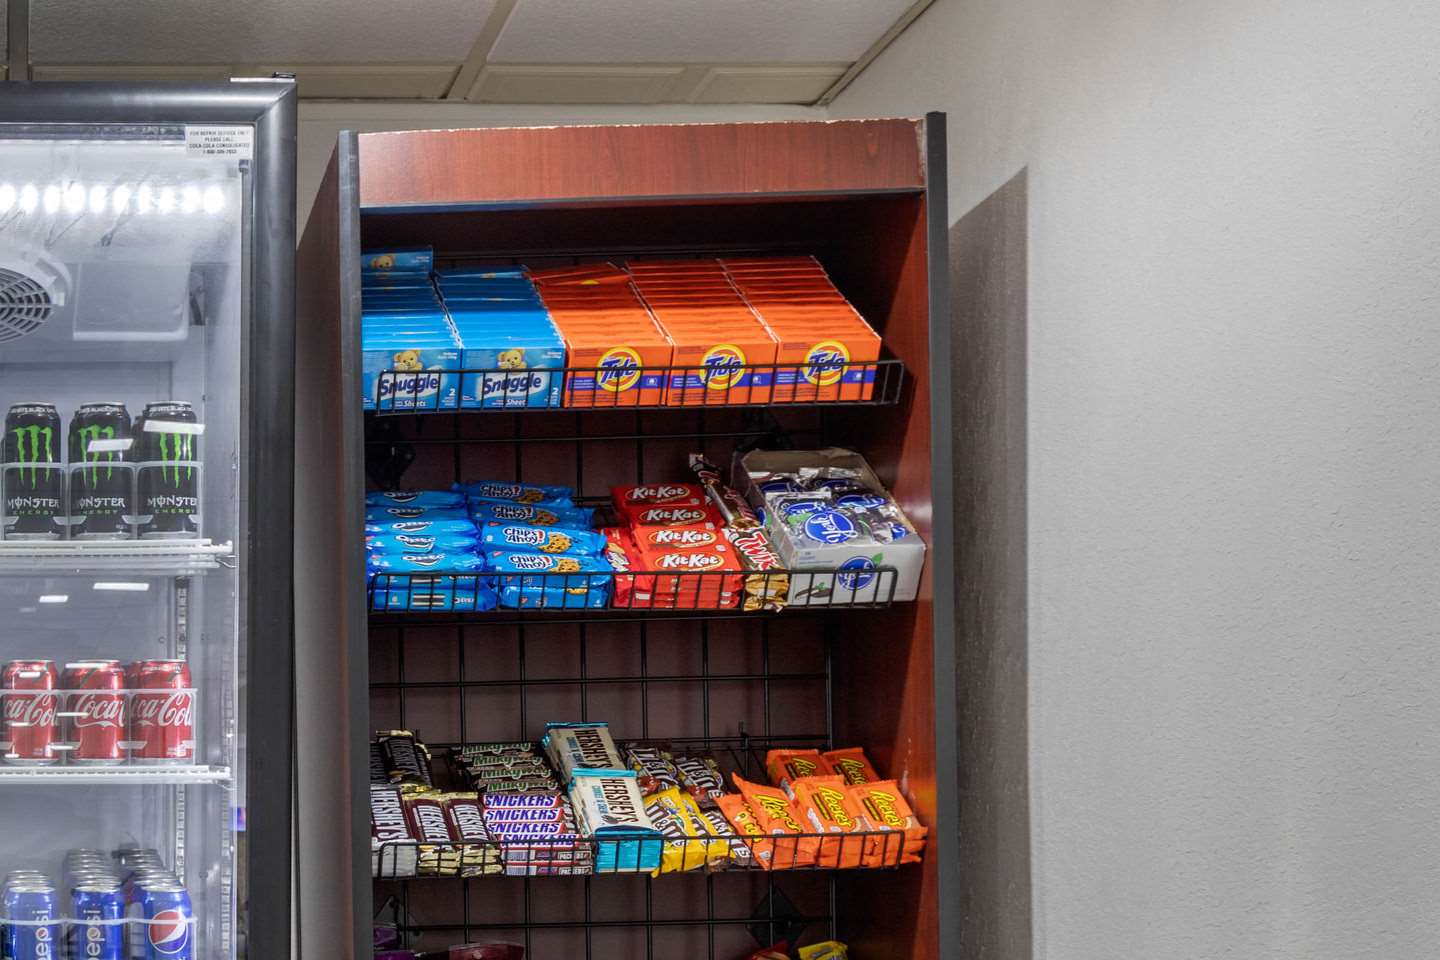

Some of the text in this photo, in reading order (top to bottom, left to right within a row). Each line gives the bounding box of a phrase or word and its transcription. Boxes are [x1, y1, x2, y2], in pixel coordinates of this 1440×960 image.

[380, 374, 439, 395] Snuggle
[484, 373, 542, 394] Snuggle
[79, 496, 125, 509] ONSTER
[484, 794, 556, 807] SNICKERS
[485, 808, 558, 821] SNICKERS
[488, 822, 560, 833] SNICKERS
